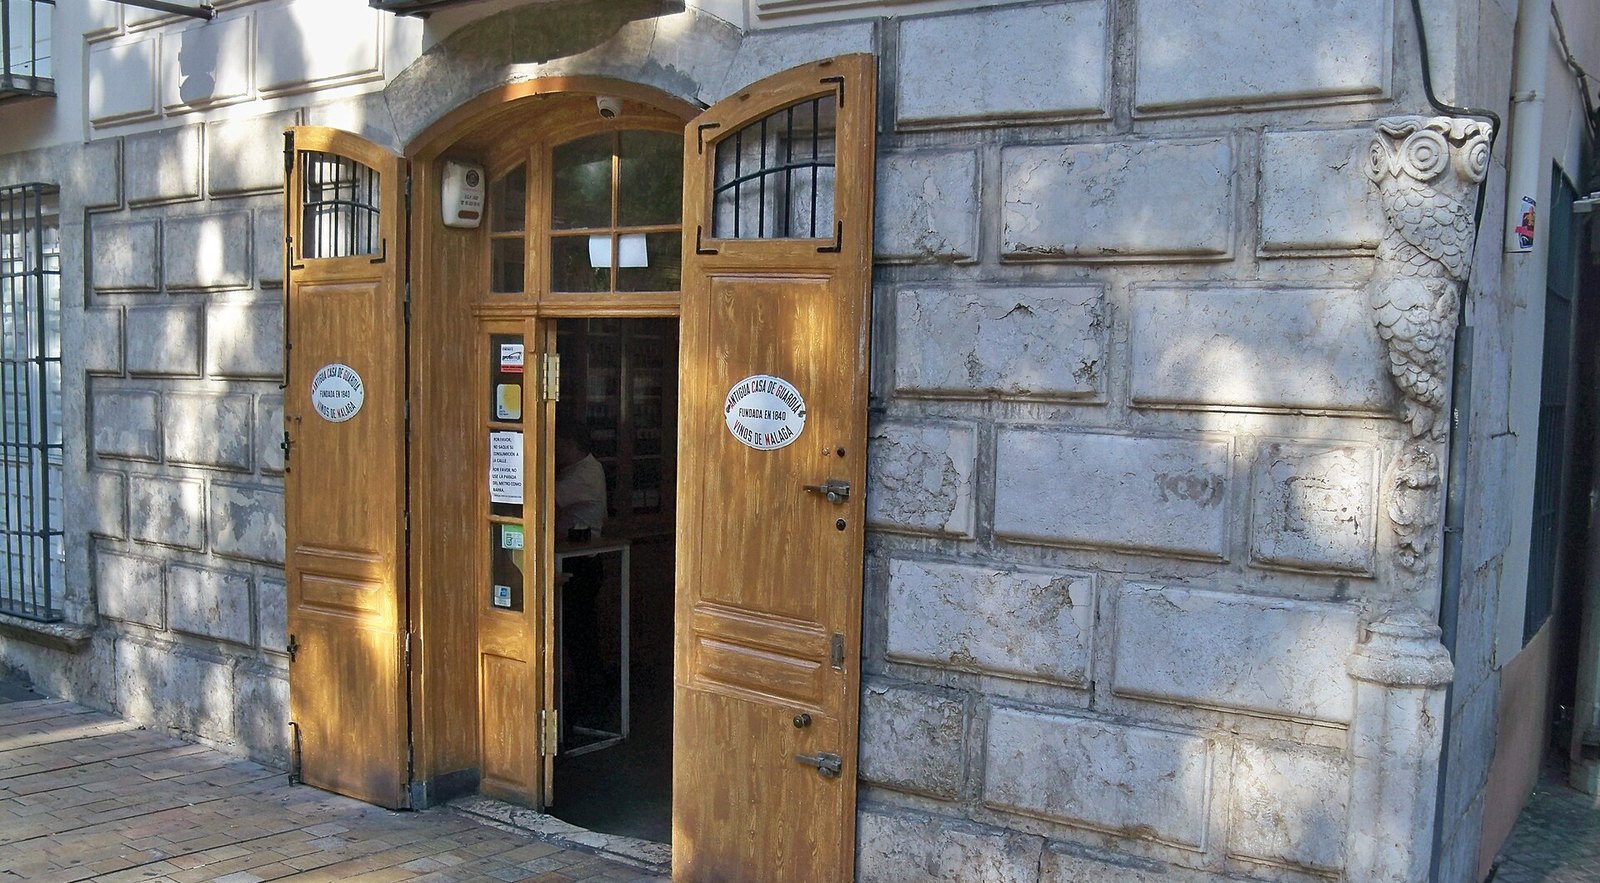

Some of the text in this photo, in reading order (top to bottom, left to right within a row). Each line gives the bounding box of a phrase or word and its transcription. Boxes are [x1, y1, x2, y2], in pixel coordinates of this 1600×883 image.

[313, 367, 361, 392] ANTIGUA CASA DE GUARDIA
[320, 390, 335, 398] FUNDADA
[335, 390, 341, 398] EN
[728, 379, 802, 414] ANTIGUA CASA DE GUARDIA
[317, 401, 356, 419] VINOS DE MALAGA
[738, 408, 787, 421] FUNDADA EN 1840
[733, 419, 794, 446] VINOS DE MALAGA
